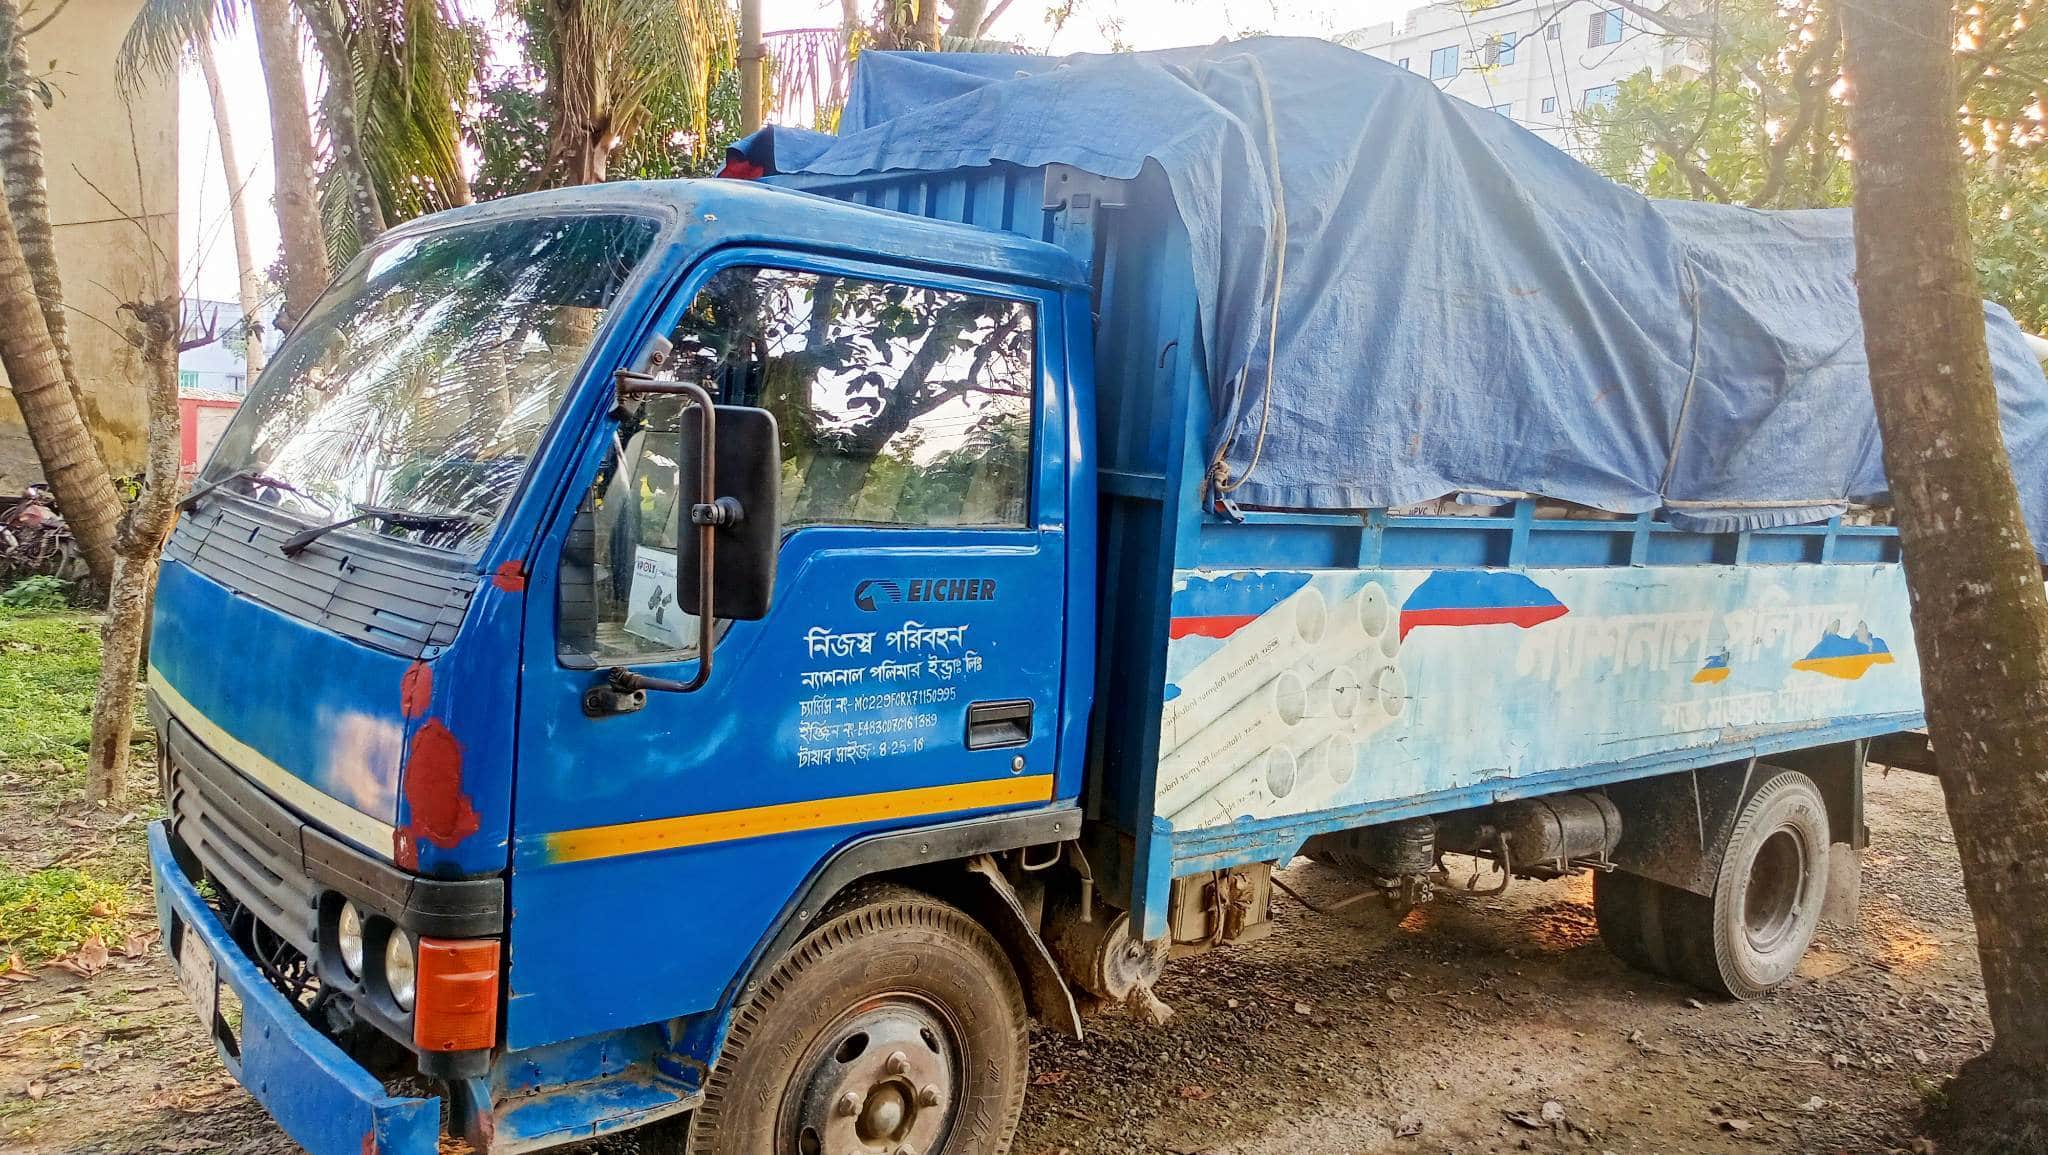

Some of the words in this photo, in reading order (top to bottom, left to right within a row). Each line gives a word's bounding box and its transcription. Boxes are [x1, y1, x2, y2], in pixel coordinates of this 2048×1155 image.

[907, 578, 997, 602] EICHER
[803, 626, 877, 659] নিজস্ব
[885, 620, 969, 654] পরিবহন
[801, 666, 867, 691] ন্যাশনাল
[869, 658, 923, 683] পলিমার
[963, 650, 983, 673] লিঃ
